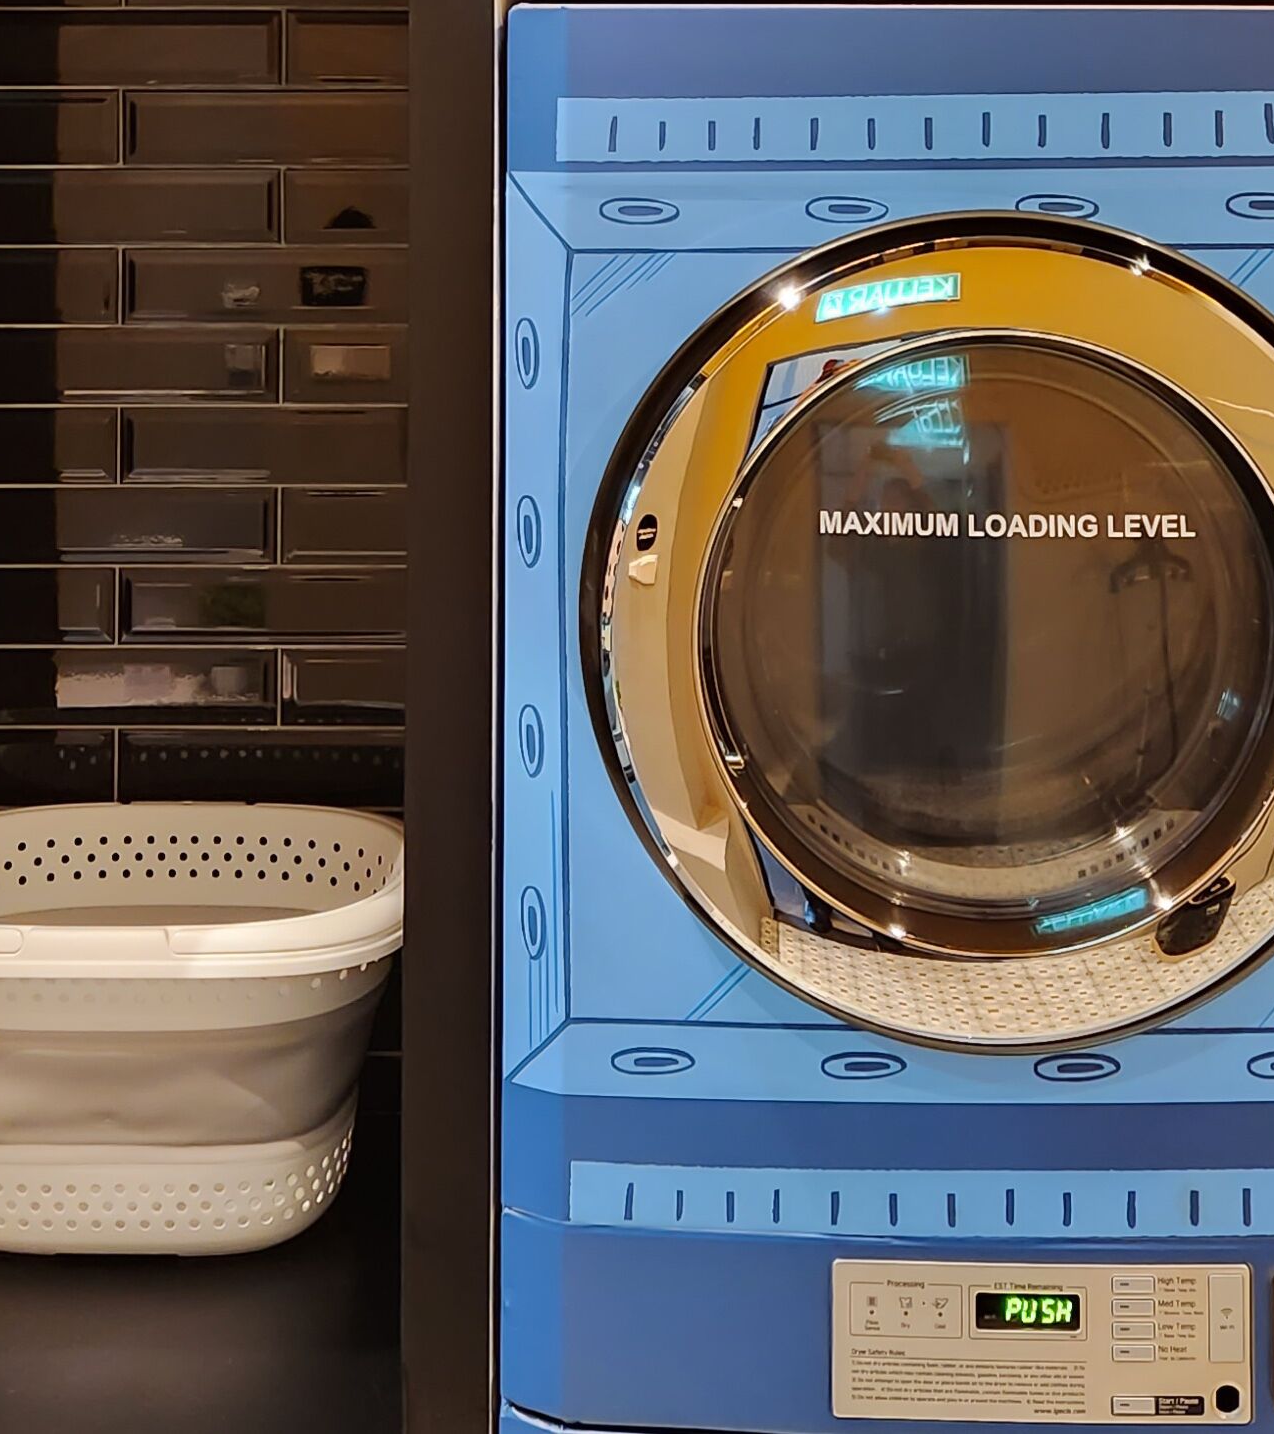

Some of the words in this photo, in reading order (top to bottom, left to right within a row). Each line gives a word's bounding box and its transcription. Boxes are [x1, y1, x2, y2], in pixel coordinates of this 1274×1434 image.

[819, 510, 959, 537] MAXIMUM
[968, 514, 1099, 538] LOADING
[1107, 514, 1196, 538] LEVEL
[1158, 1277, 1174, 1286] High
[1176, 1277, 1196, 1286] Temp
[1158, 1299, 1174, 1308] Med
[1176, 1299, 1196, 1309] Temp
[1004, 1295, 1073, 1325] PUSH
[1158, 1323, 1174, 1331] Low
[1176, 1323, 1196, 1332] Temp
[1170, 1345, 1188, 1353] Heat
